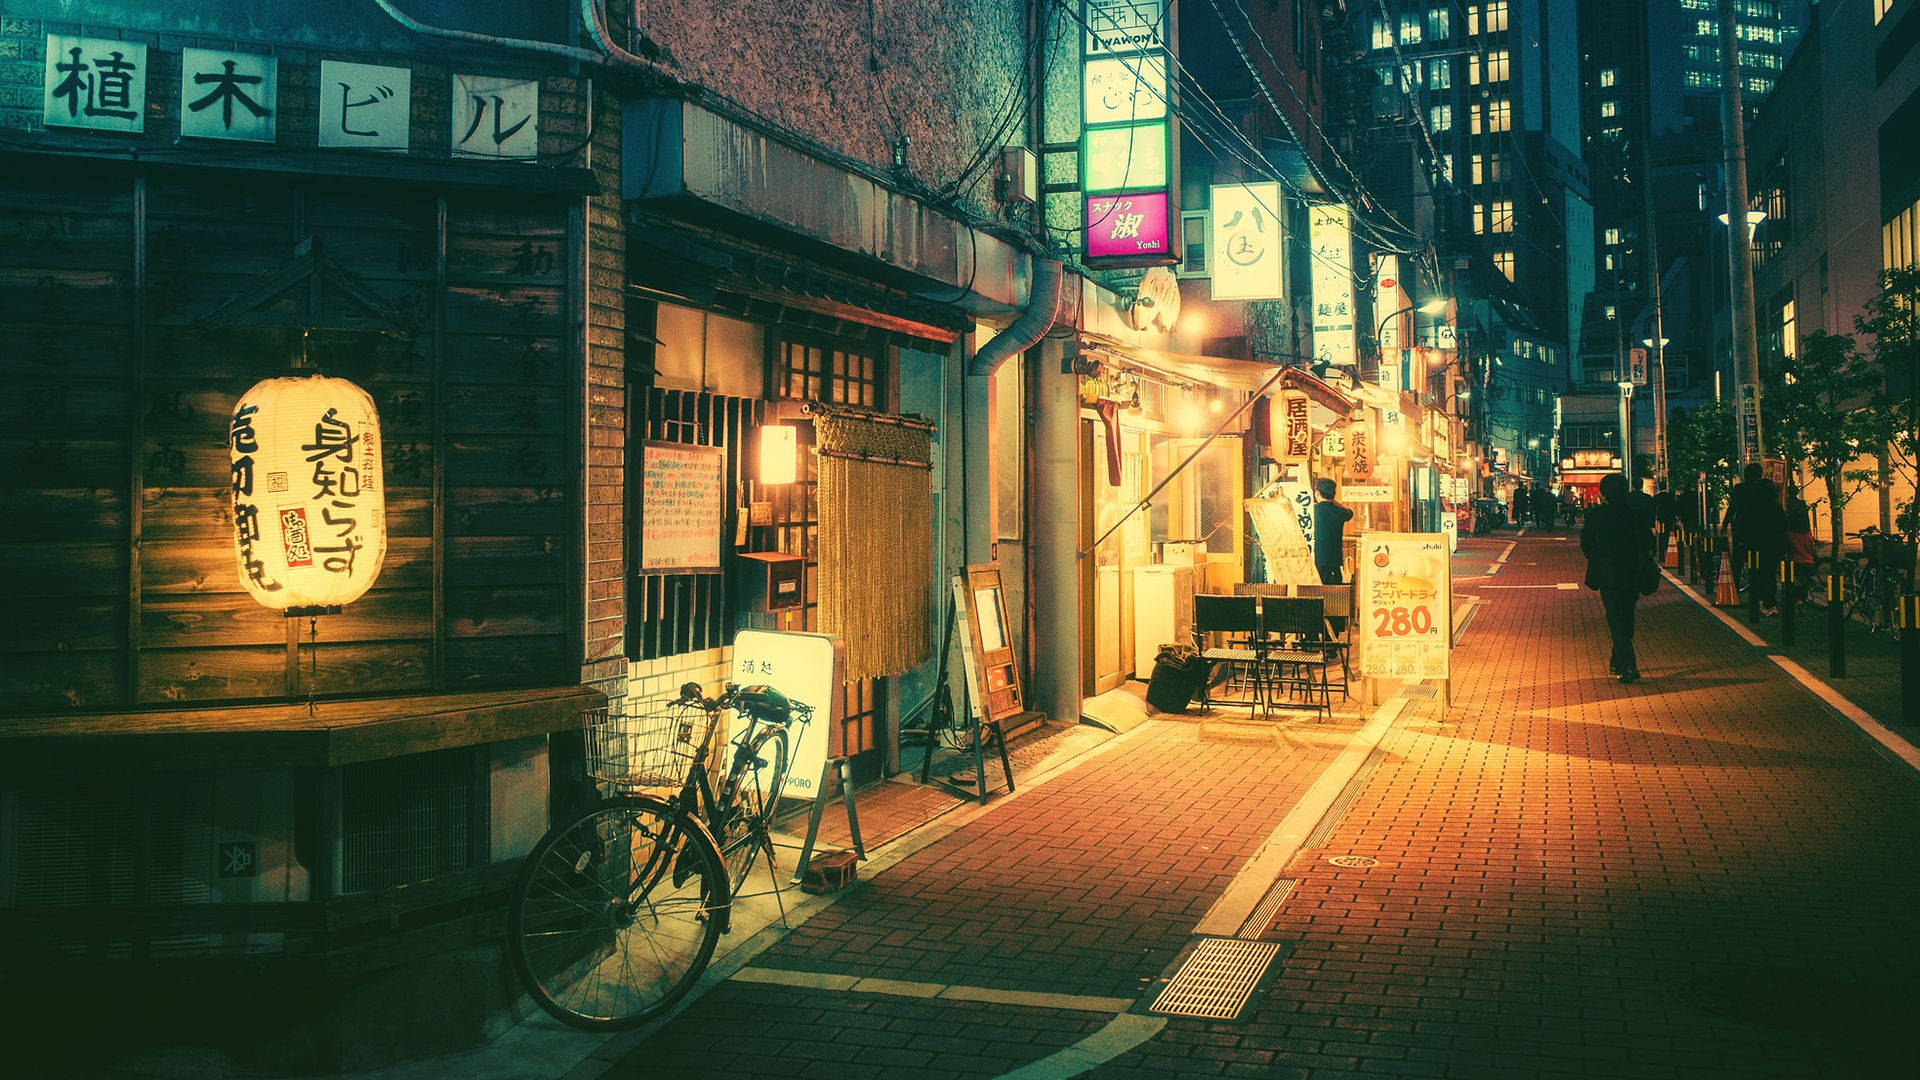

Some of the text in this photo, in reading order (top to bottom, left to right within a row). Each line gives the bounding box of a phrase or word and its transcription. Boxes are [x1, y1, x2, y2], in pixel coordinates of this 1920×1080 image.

[53, 46, 533, 146] 植木ビル
[1092, 201, 1132, 213] スナック
[1136, 241, 1161, 250] Yoshi
[1286, 398, 1308, 456] 居酒屋
[1351, 431, 1369, 475] 炭火焼
[301, 407, 363, 578] 身知らず
[1372, 580, 1398, 589] アサヒ
[1372, 590, 1438, 599] スーパードライ
